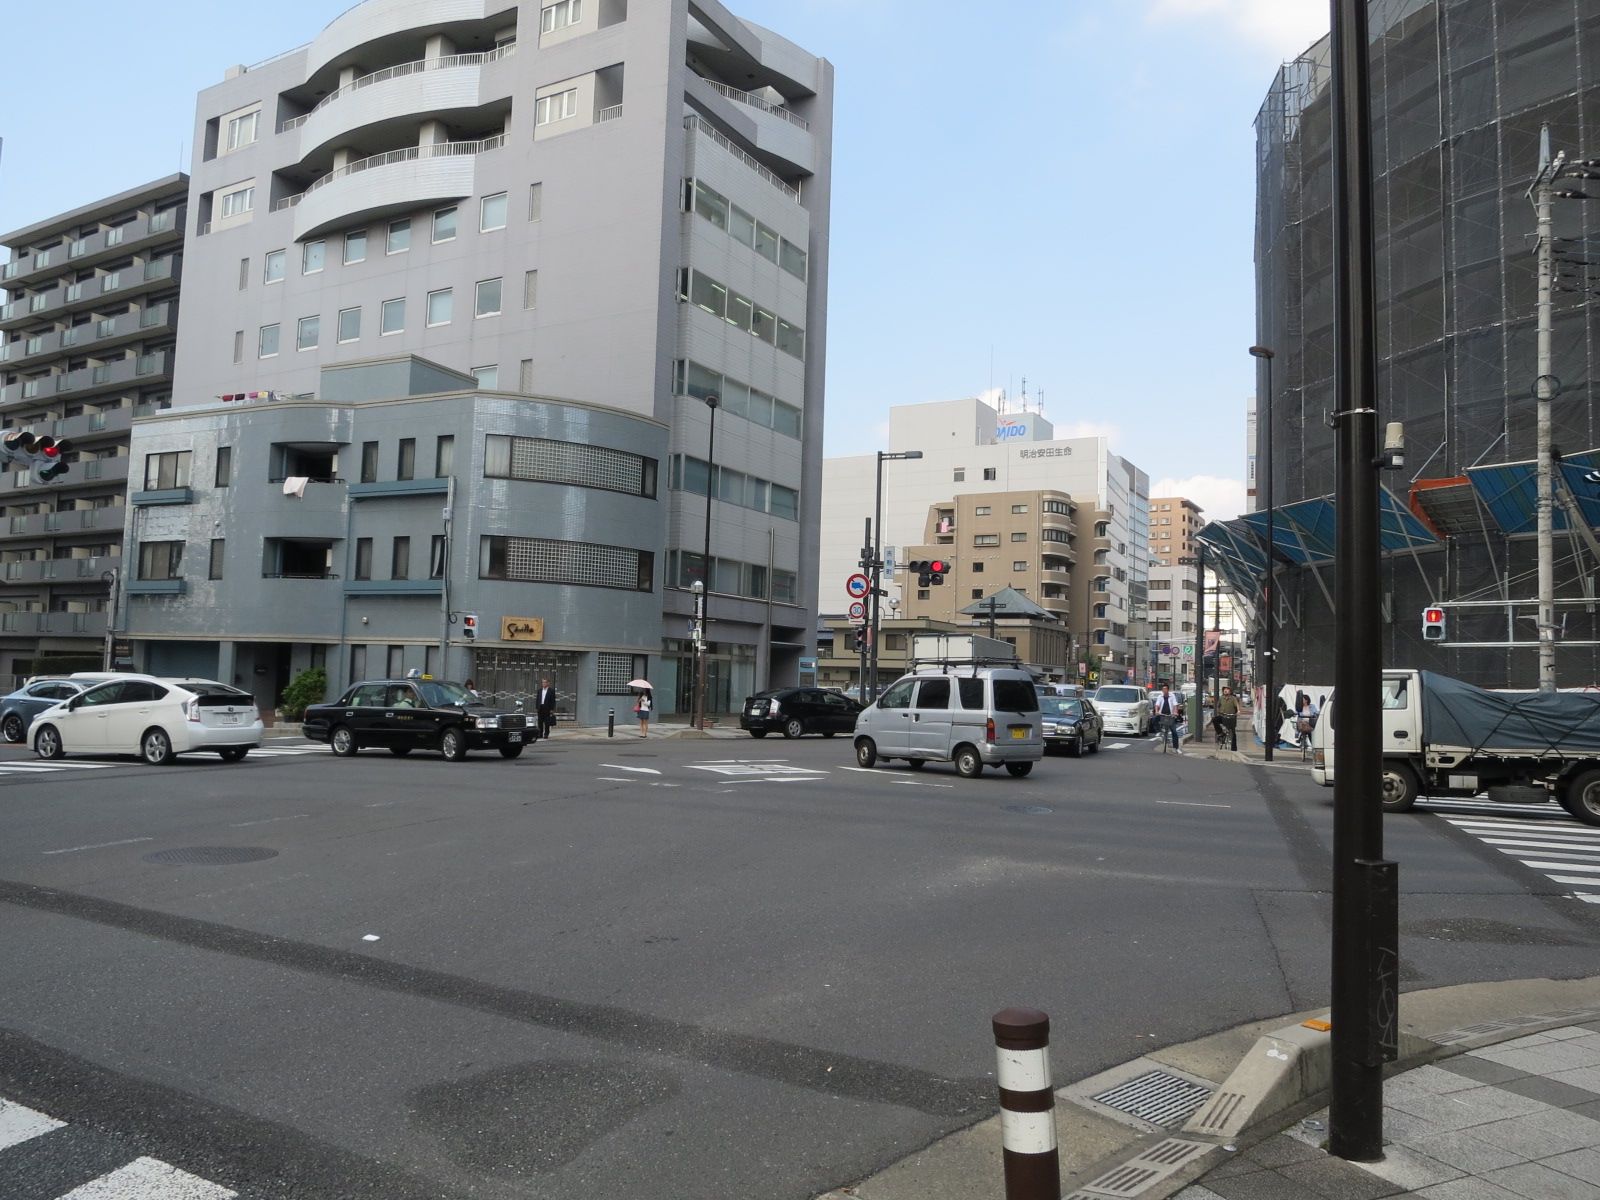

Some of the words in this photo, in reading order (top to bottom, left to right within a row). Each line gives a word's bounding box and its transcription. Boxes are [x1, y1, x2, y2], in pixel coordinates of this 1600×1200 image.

[1020, 446, 1072, 458] 明治安田生命
[852, 606, 861, 615] 30
